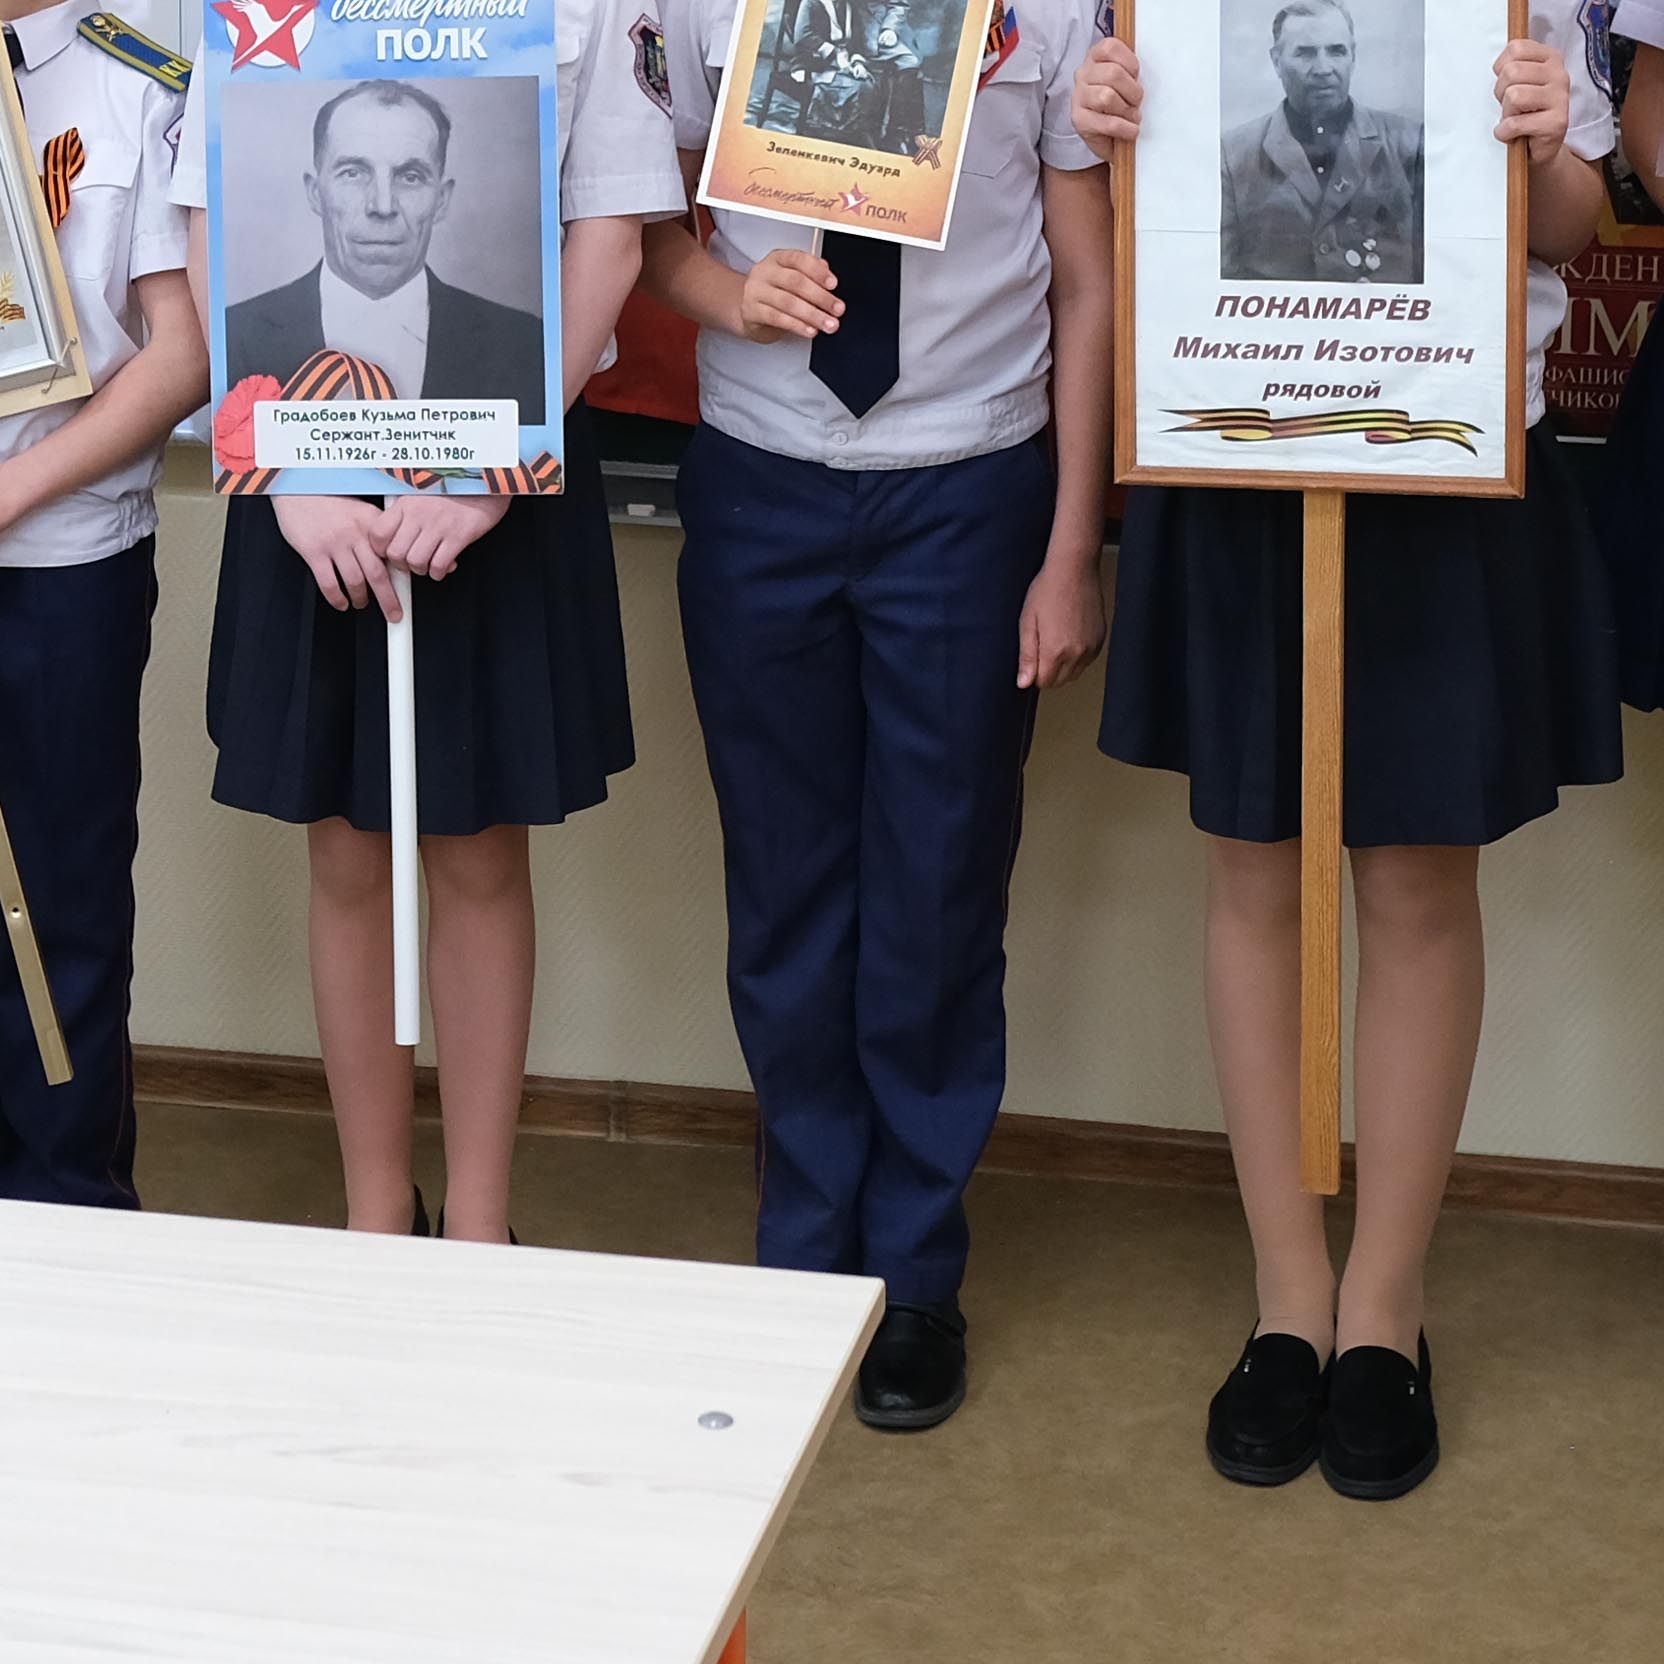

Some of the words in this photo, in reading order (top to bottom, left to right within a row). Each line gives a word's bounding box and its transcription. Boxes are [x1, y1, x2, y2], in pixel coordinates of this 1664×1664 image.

[376, 26, 488, 61] ПОЛК
[766, 141, 846, 166] Зеленкевич
[849, 157, 902, 178] Эдуард
[865, 205, 909, 224] ПОЛК
[1215, 293, 1432, 322] ПОНАМАРЁВ
[1173, 335, 1302, 362] Михаил
[1313, 338, 1475, 365] Изотович
[1262, 379, 1382, 402] рядовой
[273, 409, 357, 424] Градобоев
[362, 408, 416, 424] Кузьма
[421, 408, 496, 423] Петрович
[296, 447, 376, 461] 15.11.1926г
[392, 447, 476, 461] 28.10.1980г
